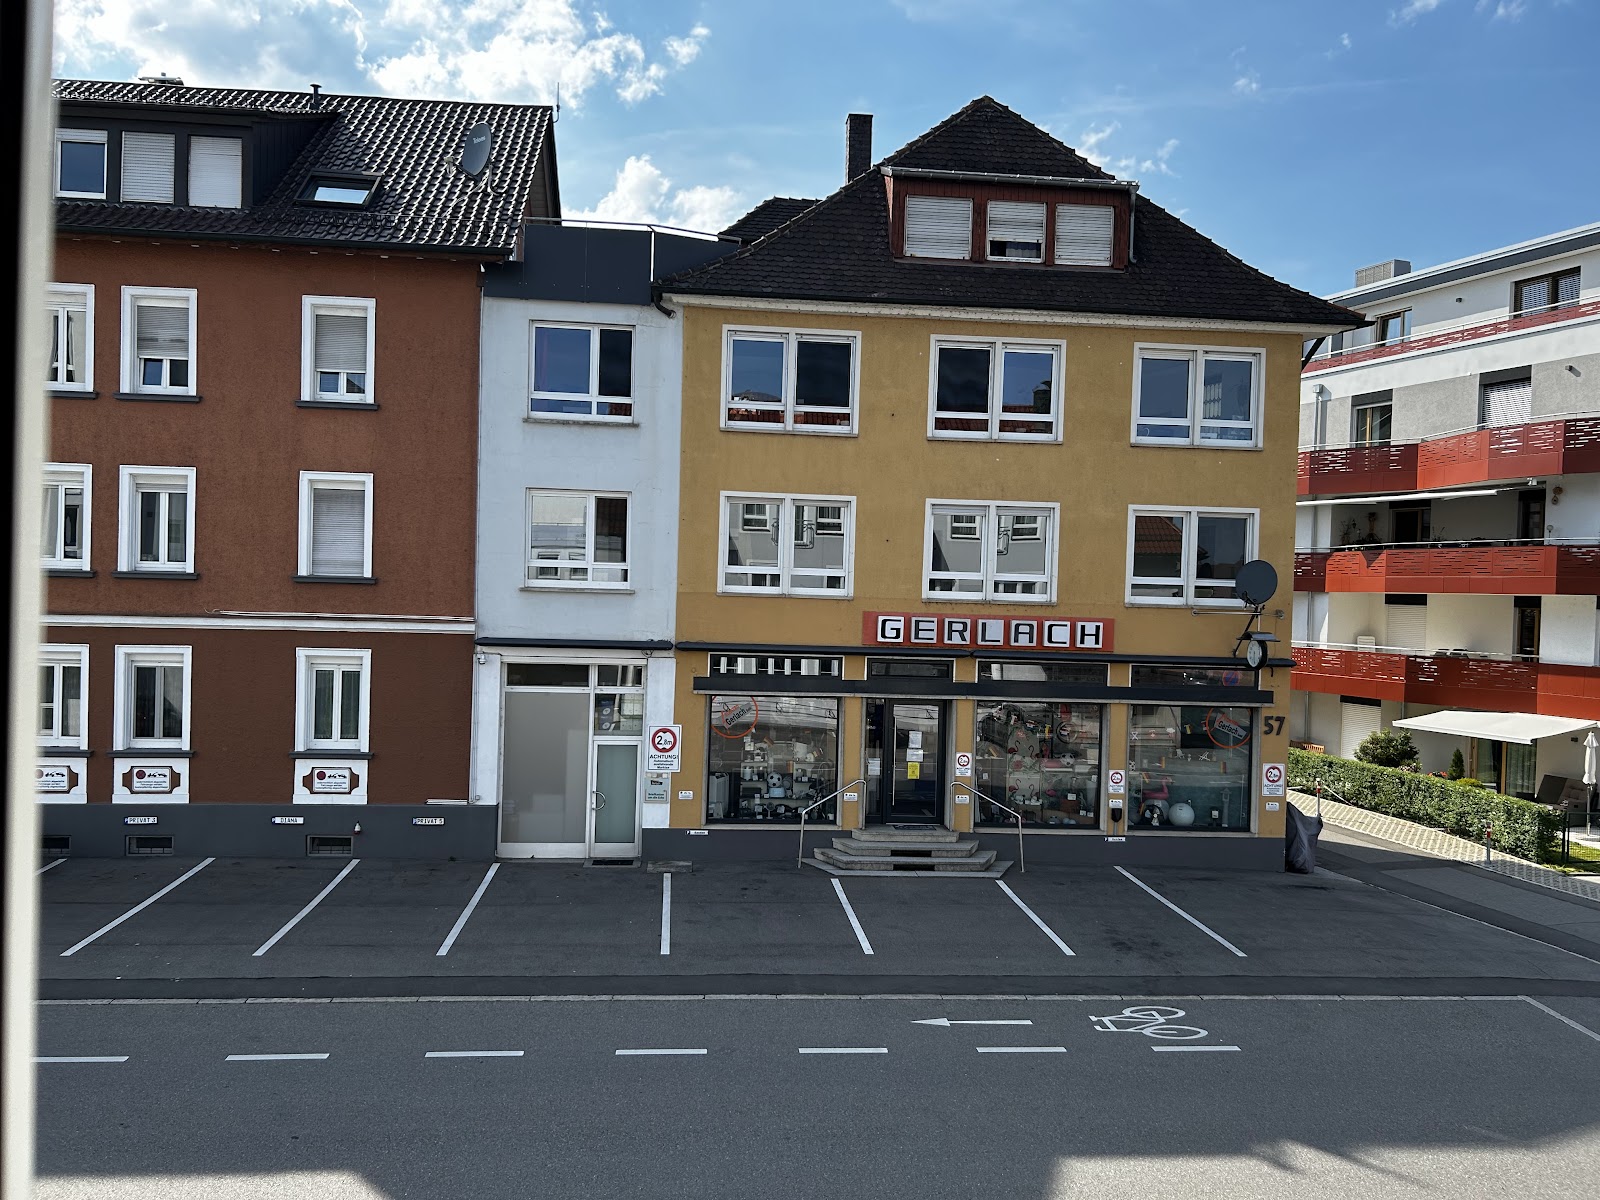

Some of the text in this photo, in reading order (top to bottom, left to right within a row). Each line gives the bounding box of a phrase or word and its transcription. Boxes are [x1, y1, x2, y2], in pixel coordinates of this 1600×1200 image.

[880, 618, 1100, 646] GERLACH
[725, 707, 746, 726] Gerlach
[1264, 715, 1286, 736] 57
[1218, 720, 1239, 736] Gerlach
